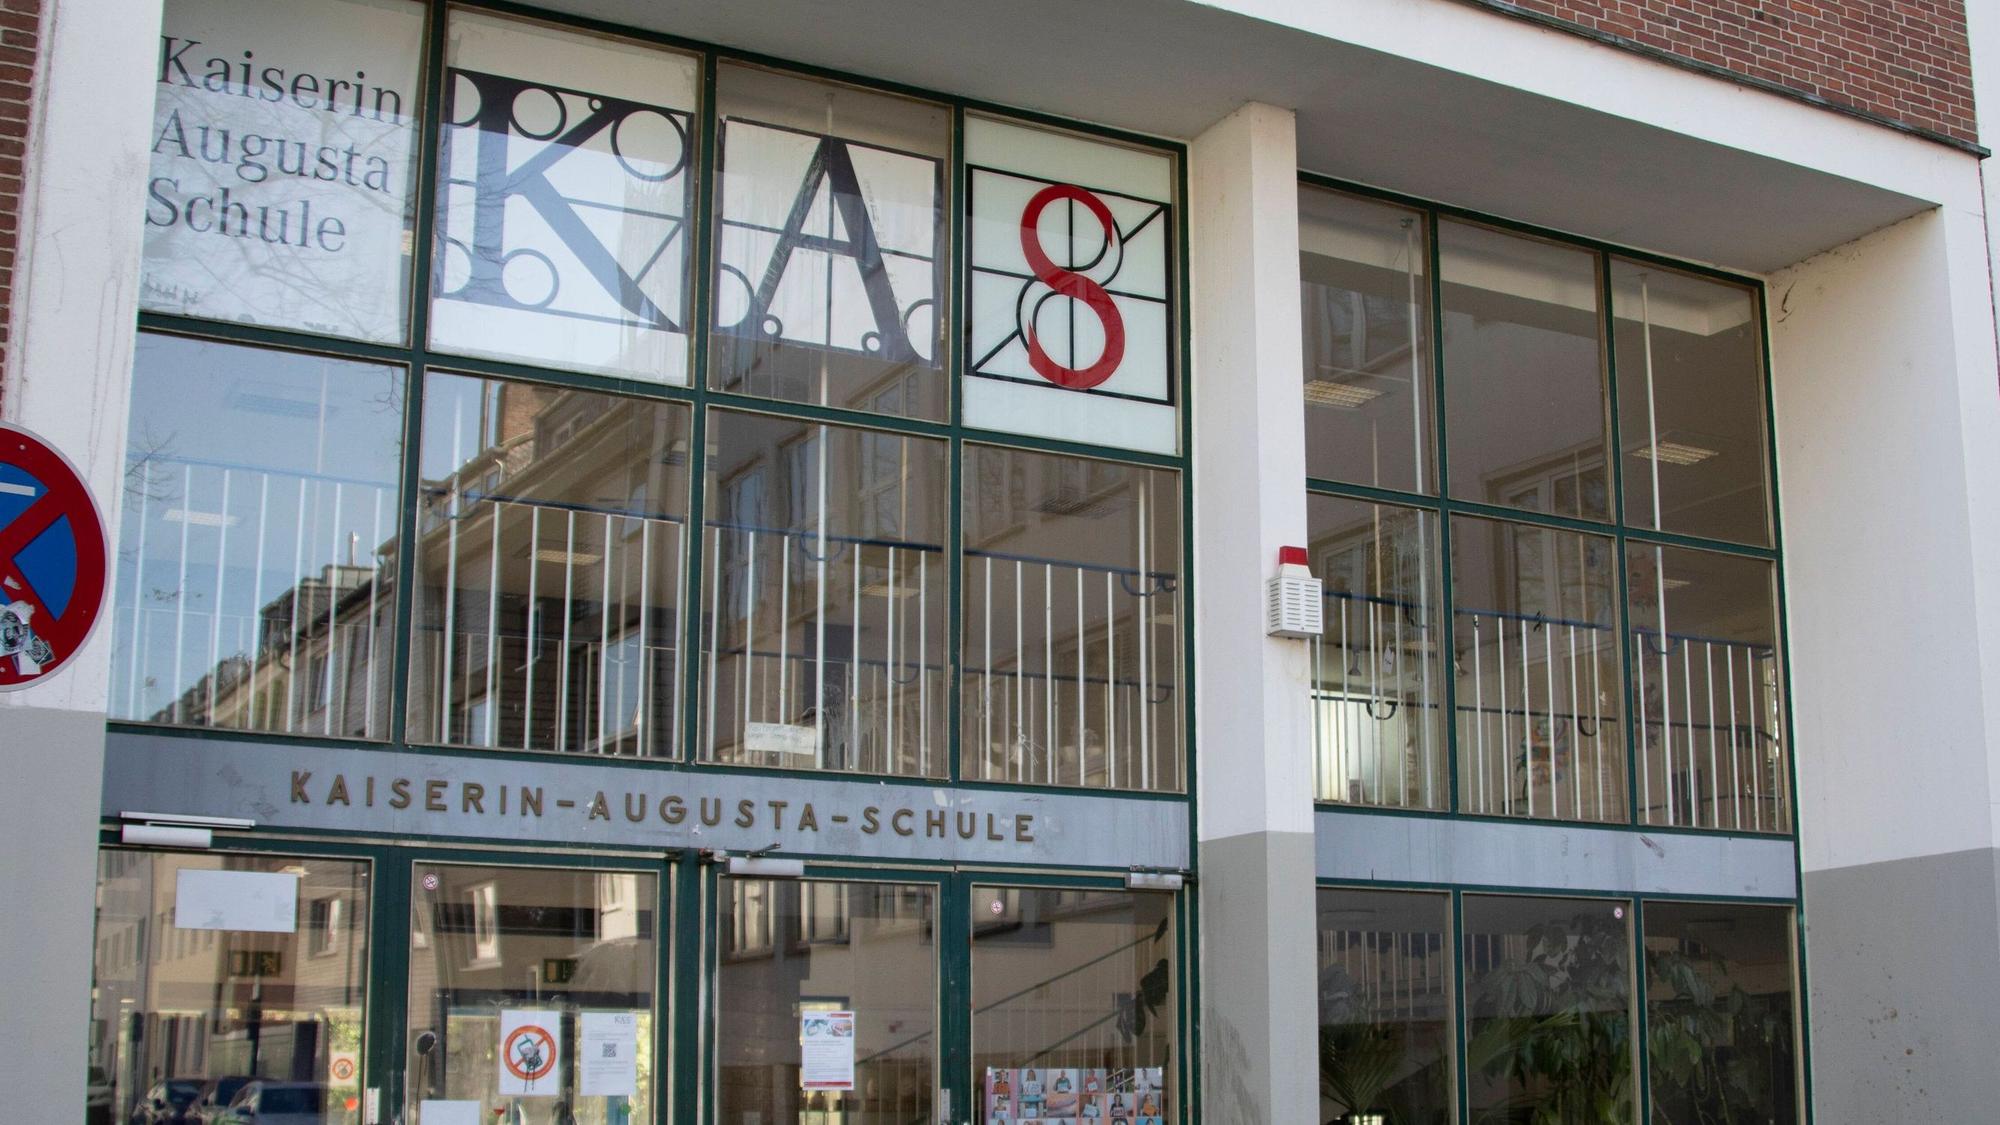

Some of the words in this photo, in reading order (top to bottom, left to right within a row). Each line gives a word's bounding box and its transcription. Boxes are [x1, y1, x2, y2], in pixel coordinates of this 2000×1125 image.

[157, 35, 404, 127] Kaiserin
[151, 108, 391, 193] Augusta
[145, 177, 346, 252] Schule
[291, 770, 1034, 842] KAISERIN-AUGUSTA-SCHULE
